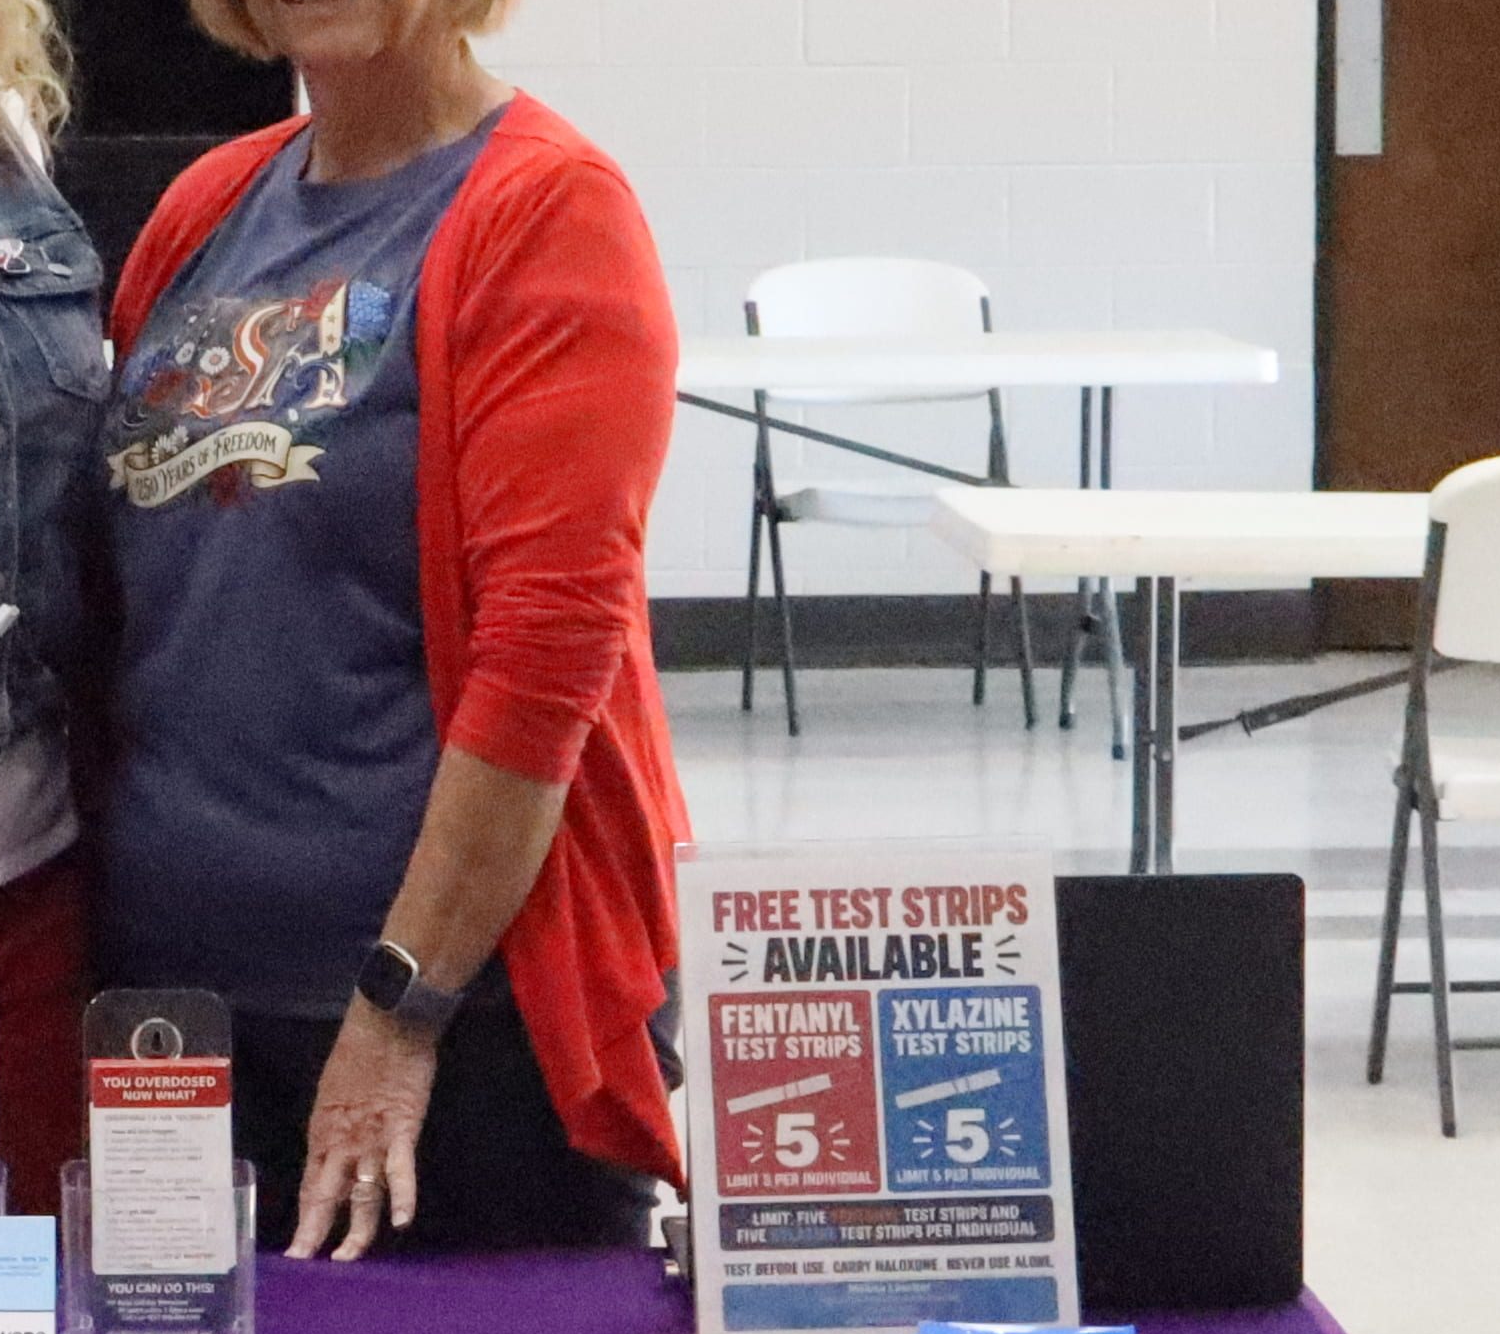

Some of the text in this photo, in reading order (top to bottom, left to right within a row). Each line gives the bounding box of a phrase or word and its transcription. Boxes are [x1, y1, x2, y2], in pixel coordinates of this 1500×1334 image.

[213, 431, 277, 460] FREEDOM
[712, 883, 1029, 934] FREE TEST STRIPS
[762, 932, 985, 984] AVAILABLE
[721, 1000, 861, 1036] FENTANYL
[892, 995, 1030, 1033] XYLAZINE
[724, 1034, 863, 1061] TEST STRIPS
[895, 1030, 1033, 1058] TEST STRIPS
[102, 1075, 217, 1088] YOU OVERDOSED
[122, 1089, 197, 1101] NOW WHAT?
[774, 1112, 820, 1169] 5
[945, 1107, 991, 1164] 5
[802, 1170, 874, 1186] INDIVIDUAL
[797, 1209, 828, 1225] FIVE
[903, 1207, 938, 1222] TEST
[940, 1205, 988, 1221] STRIPS
[990, 1204, 1020, 1220] AND
[736, 1228, 767, 1244] FIVE
[840, 1225, 873, 1240] TEST
[875, 1224, 924, 1240] STRIPS
[926, 1223, 952, 1239] PER
[955, 1221, 1037, 1238] INDIVIDUAL
[724, 1262, 752, 1277] TEST
[107, 1282, 134, 1294] YOU
[136, 1282, 161, 1294] CAN
[164, 1282, 183, 1294] DO
